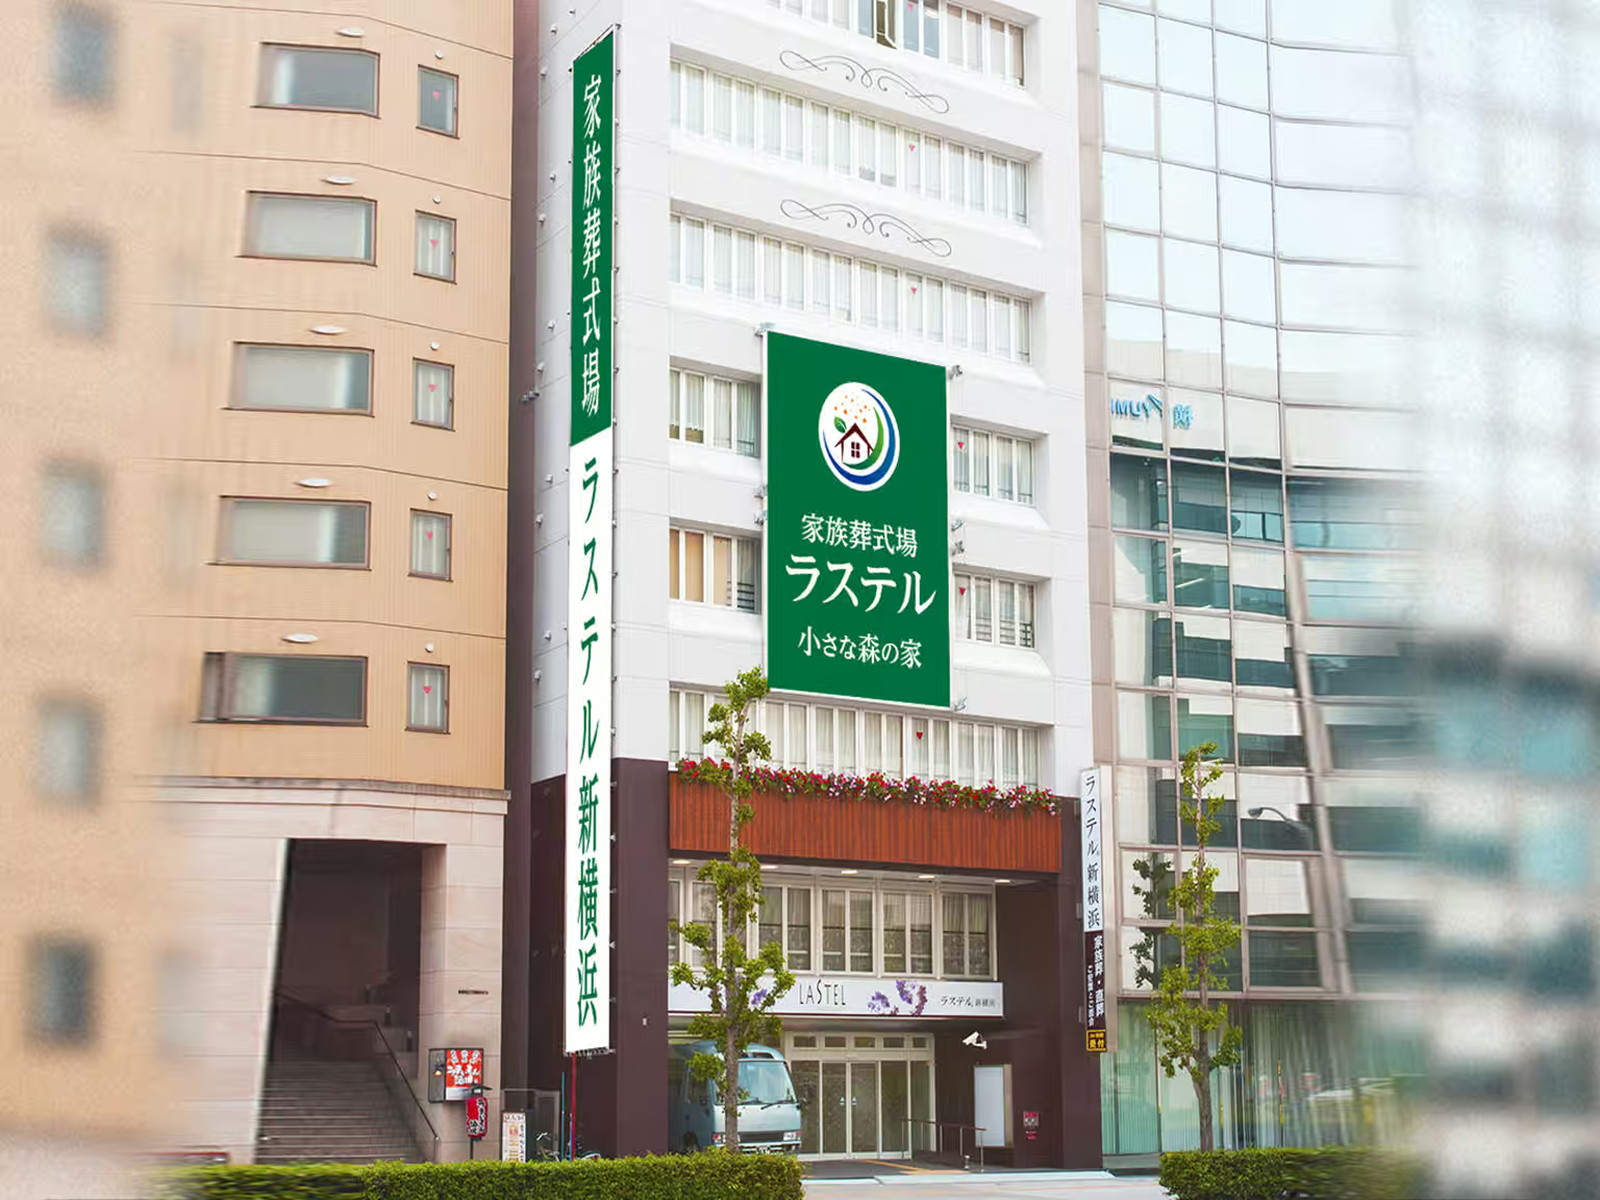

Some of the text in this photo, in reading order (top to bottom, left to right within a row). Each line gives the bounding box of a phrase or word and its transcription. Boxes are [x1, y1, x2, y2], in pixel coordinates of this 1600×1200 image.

[582, 75, 602, 416] 家族葬式場
[801, 513, 917, 558] 家族葬式場
[786, 554, 936, 614] ラステル
[798, 626, 922, 669] 小さな森の家
[577, 457, 599, 1027] ラステル新横浜
[799, 978, 846, 1006] LASTEL
